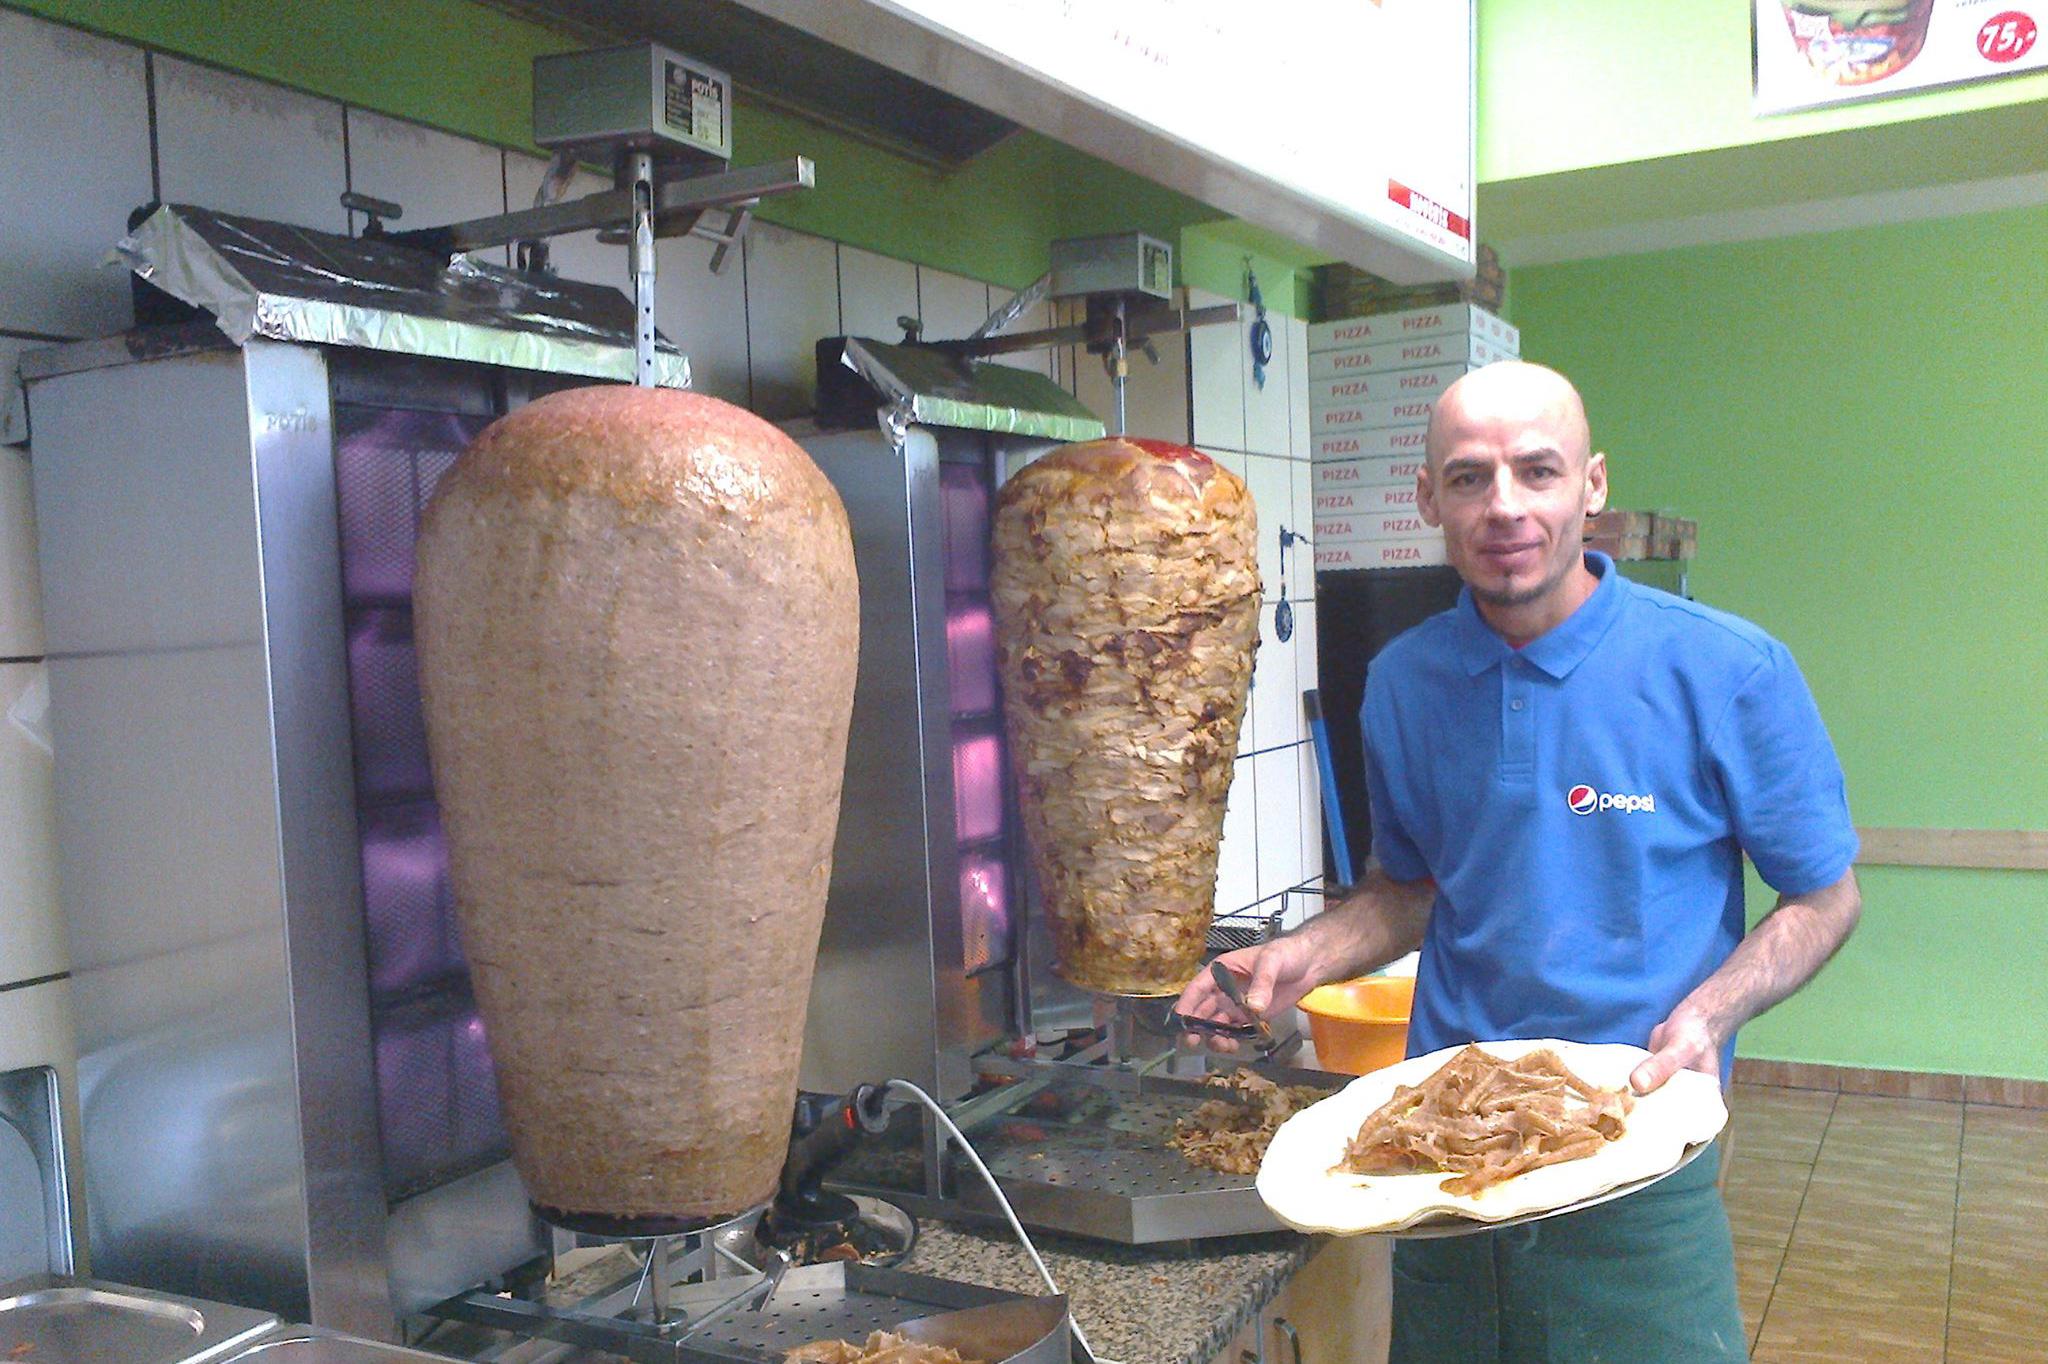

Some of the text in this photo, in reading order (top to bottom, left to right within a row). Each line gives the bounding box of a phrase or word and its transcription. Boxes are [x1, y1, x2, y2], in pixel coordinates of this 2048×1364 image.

[1335, 316, 1441, 340] PIZZA PIZZA
[1335, 345, 1440, 369] PIZZA PIZZA
[1332, 375, 1437, 397] PIZZA PIZZA
[1327, 404, 1432, 424] PIZZA PIZZA
[1323, 440, 1359, 454] PIZZA
[1323, 463, 1418, 481] PIZZA PIZZ
[1318, 492, 1417, 508] PIZZA PIZZ
[1316, 519, 1420, 535] PIZZA PIZZA
[1314, 548, 1420, 563] PIZZA PIZZA
[1599, 793, 1655, 813] pepsi
